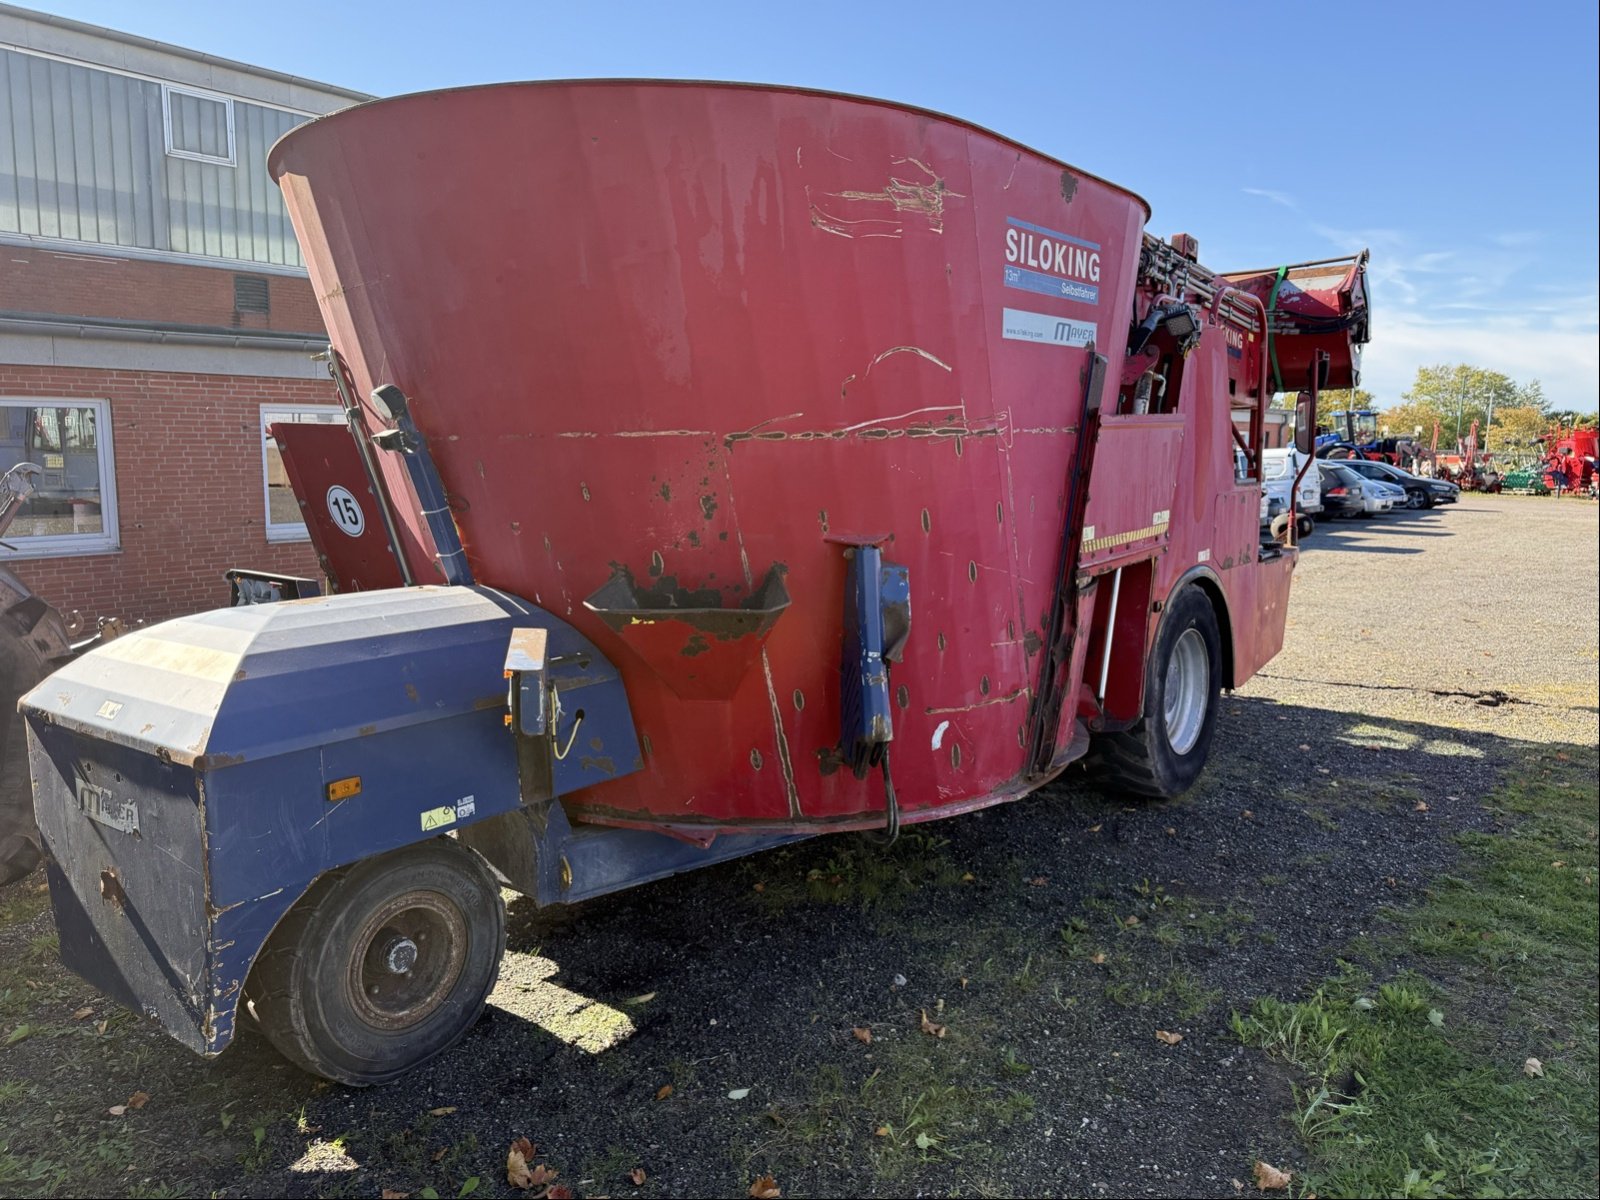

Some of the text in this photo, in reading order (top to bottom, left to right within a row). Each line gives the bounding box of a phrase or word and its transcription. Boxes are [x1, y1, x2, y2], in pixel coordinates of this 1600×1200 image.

[1005, 228, 1100, 282] SILOKING
[1061, 282, 1096, 300] Selbstfahrer
[1006, 322, 1094, 341] www.siloking.com MAYER
[332, 497, 359, 526] 15
